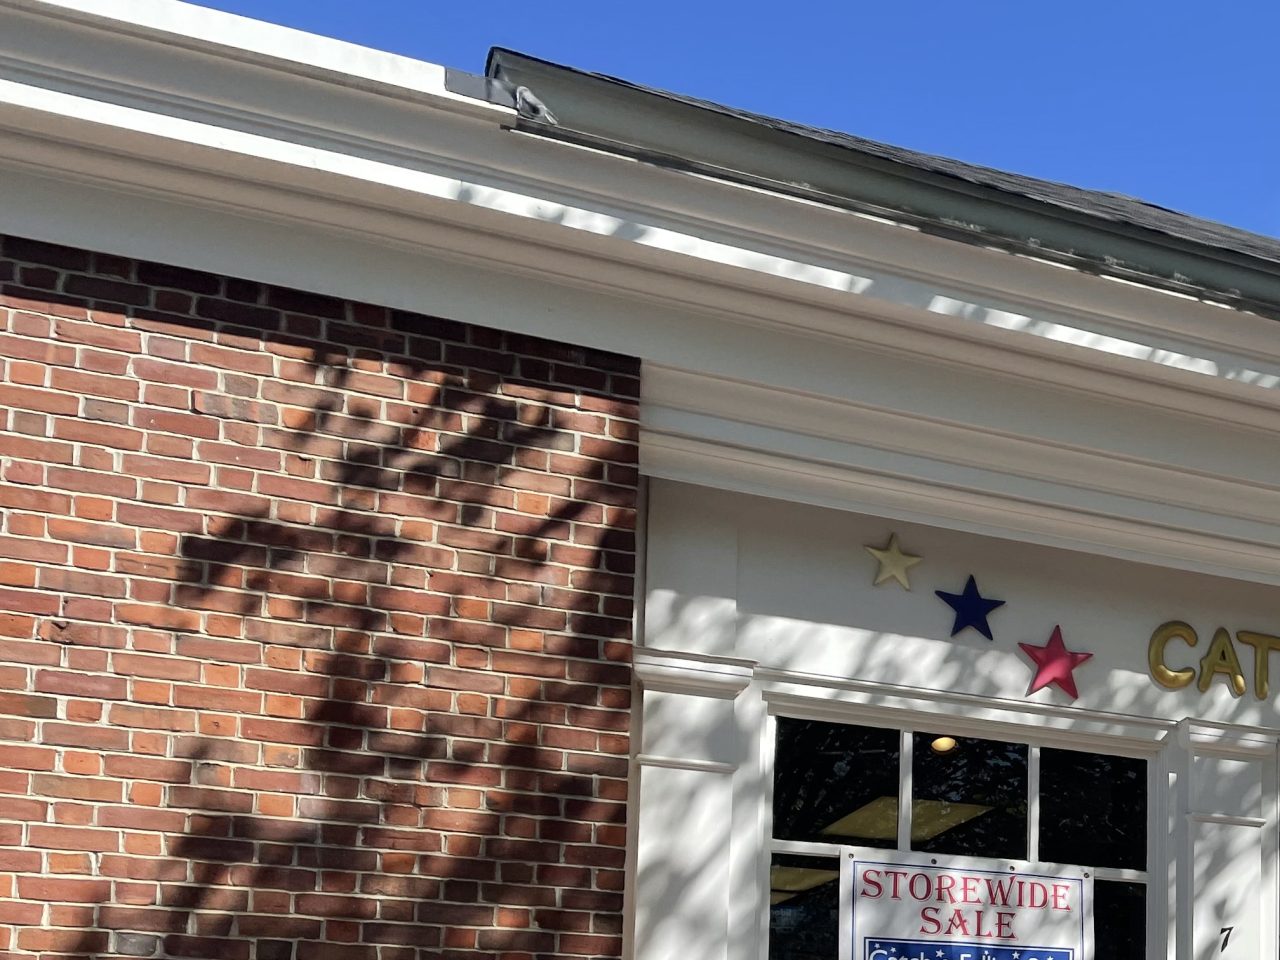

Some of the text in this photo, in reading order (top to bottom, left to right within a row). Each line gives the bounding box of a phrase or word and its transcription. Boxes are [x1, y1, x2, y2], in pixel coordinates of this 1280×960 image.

[861, 868, 1071, 911] STOREWIDE
[920, 906, 1018, 940] SALE
[1220, 926, 1234, 952] 7
